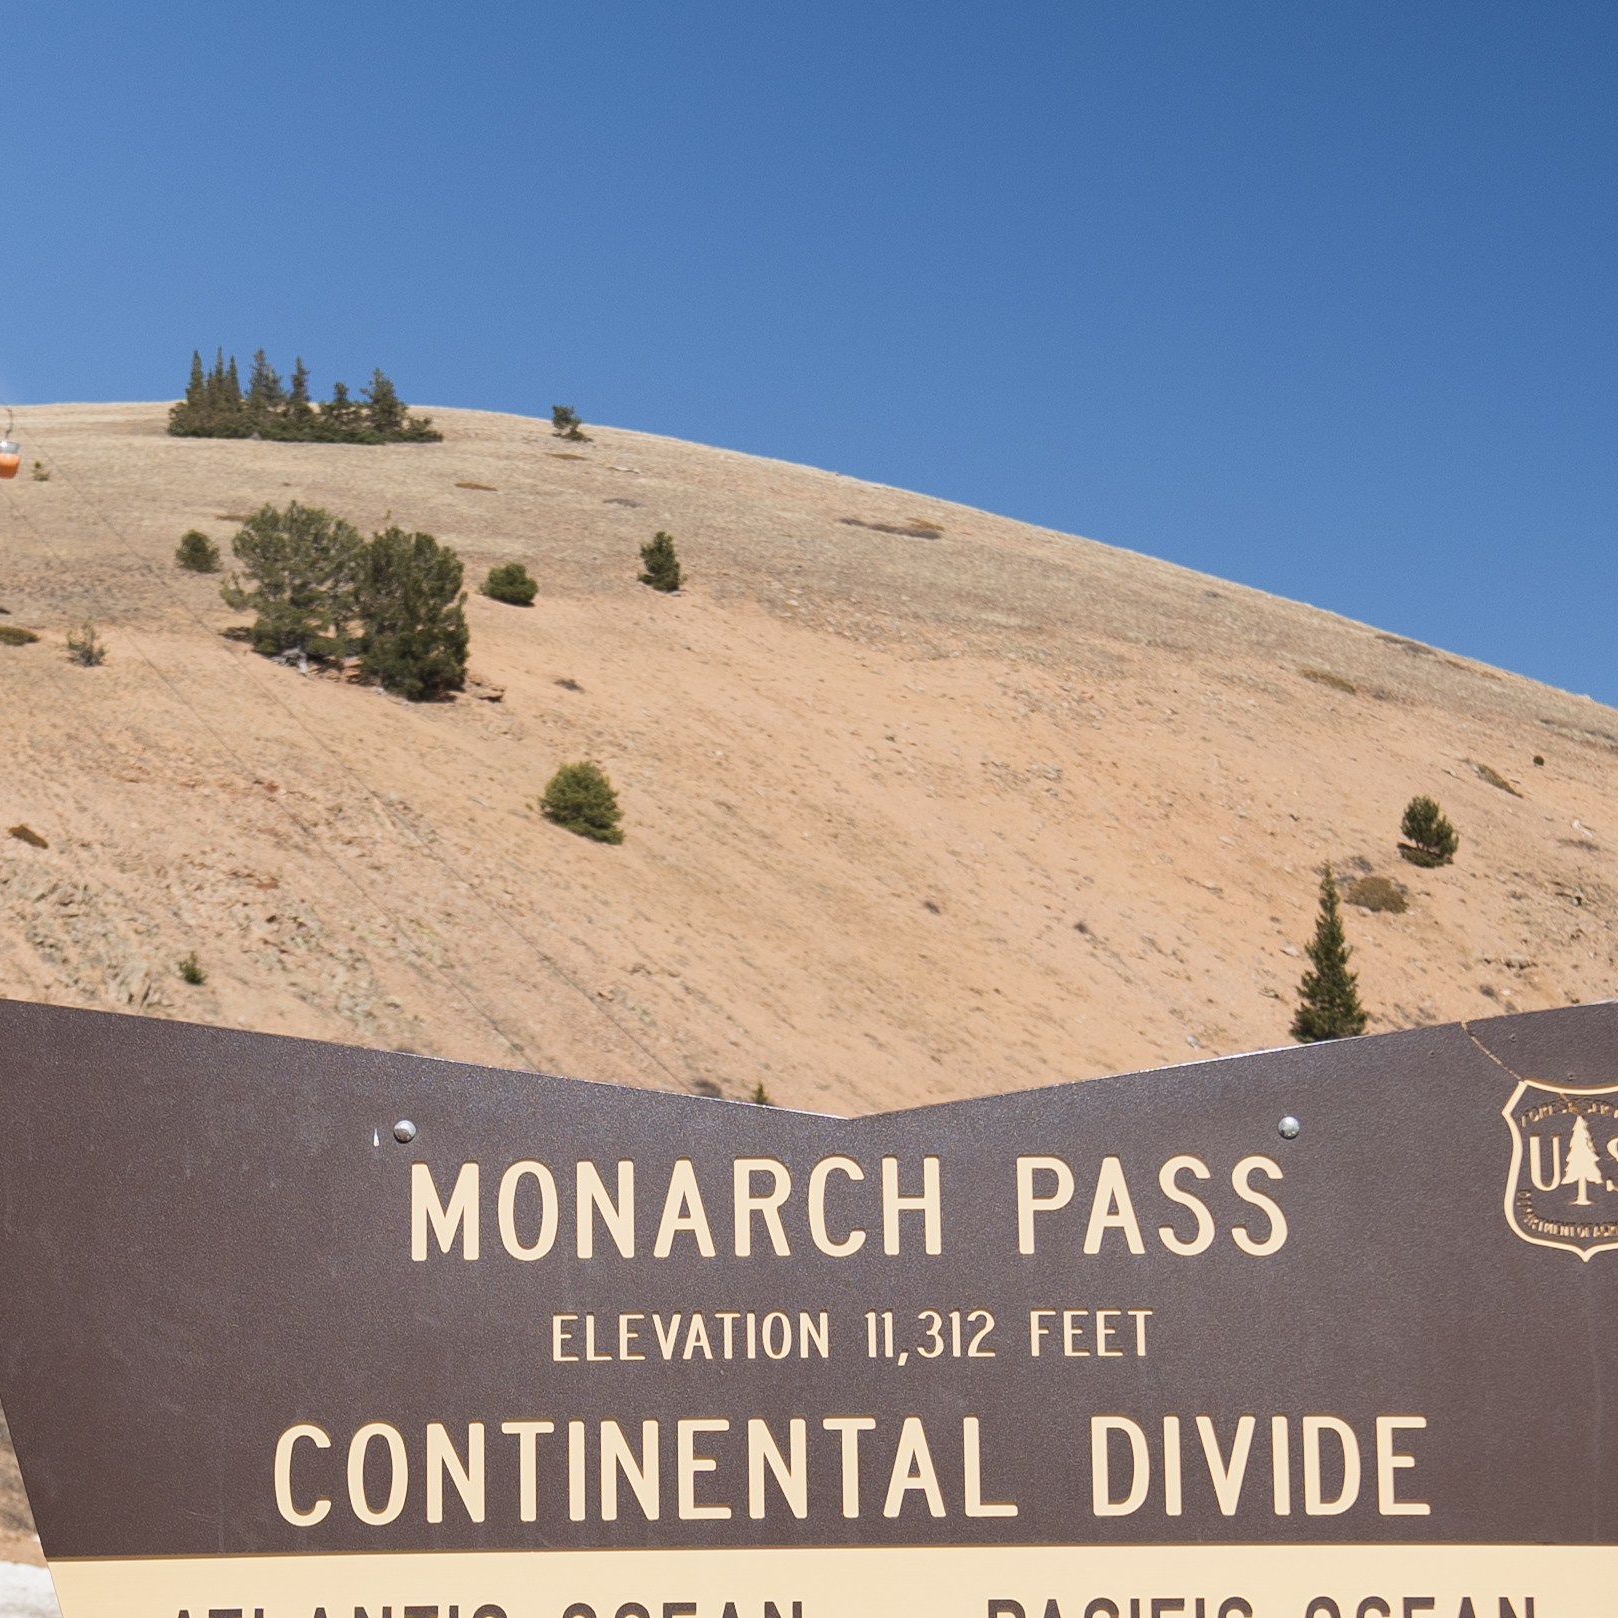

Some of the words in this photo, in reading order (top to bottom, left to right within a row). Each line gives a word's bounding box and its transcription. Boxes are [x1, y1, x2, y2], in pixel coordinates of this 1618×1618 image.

[412, 1157, 941, 1261] MONARCH
[1017, 1156, 1287, 1256] PASS
[553, 1313, 828, 1361] ELEVATION
[865, 1311, 995, 1366] 11,312
[1031, 1311, 1152, 1356] FEET
[275, 1417, 1018, 1526] CONTINENTAL
[1091, 1416, 1430, 1516] DIVIDE
